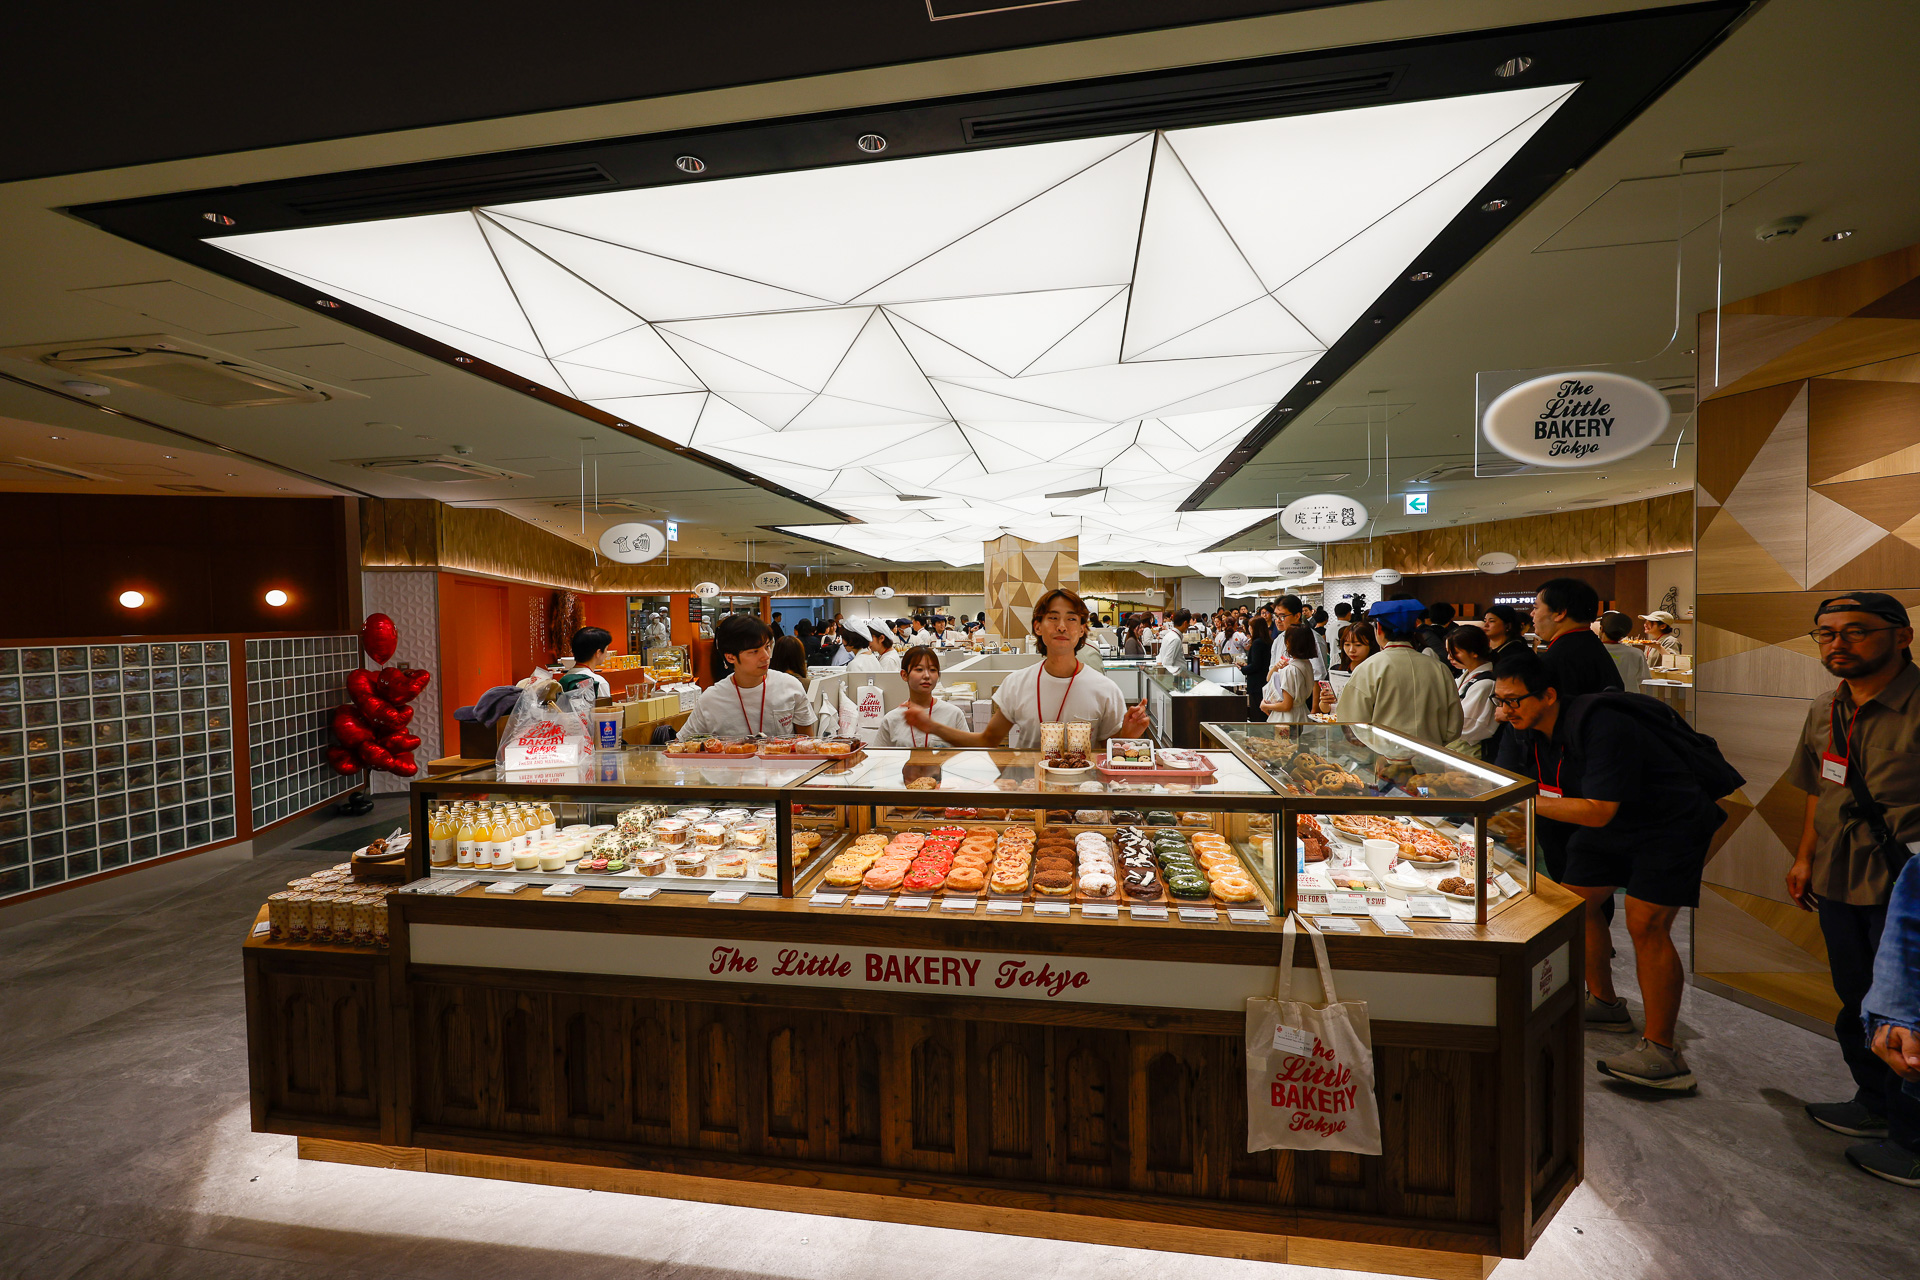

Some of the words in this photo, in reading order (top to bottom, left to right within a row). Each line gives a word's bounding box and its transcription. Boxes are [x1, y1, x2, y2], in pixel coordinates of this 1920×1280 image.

[1557, 380, 1594, 398] The
[1539, 398, 1610, 419] Little
[1534, 418, 1615, 439] BAKERY
[1549, 440, 1600, 458] Tokyo
[1294, 511, 1338, 524] 虎子堂
[518, 735, 565, 746] BAKERY
[1308, 895, 1320, 903] FOR
[709, 945, 759, 975] The
[771, 948, 852, 978] Little
[865, 953, 982, 987] BAKERY
[994, 960, 1091, 997] Tokyo
[1308, 1037, 1335, 1062] he
[1276, 1056, 1351, 1088] Little
[1271, 1082, 1358, 1114] BAKERY
[1288, 1111, 1347, 1138] Tokyo
